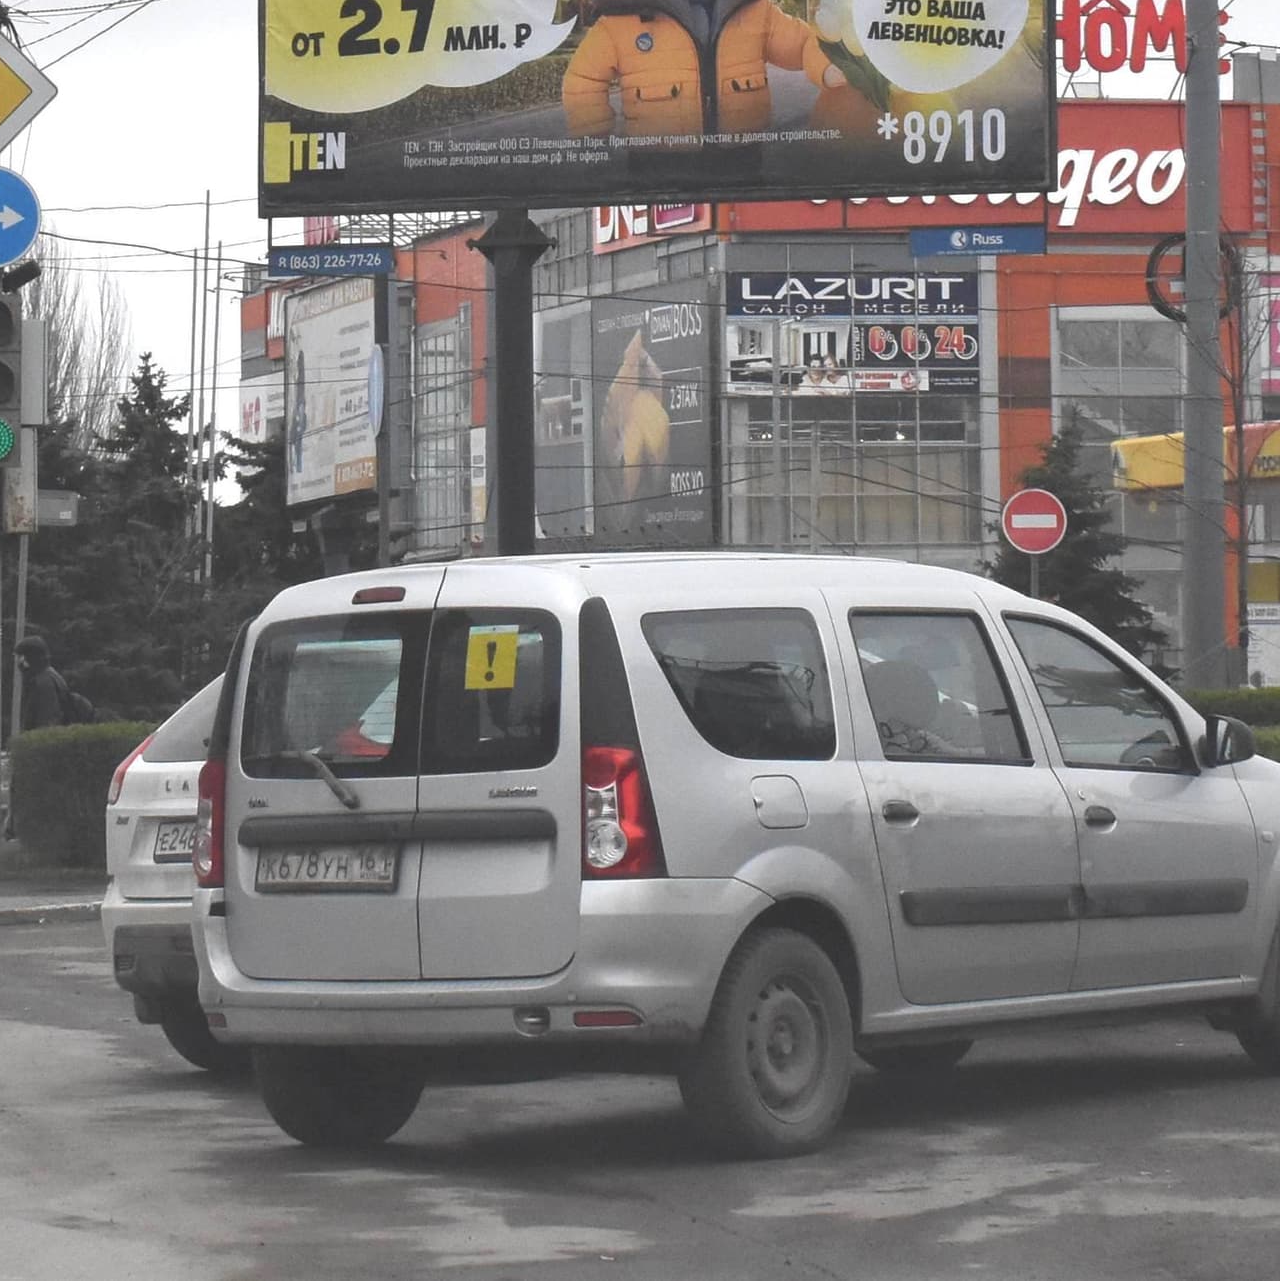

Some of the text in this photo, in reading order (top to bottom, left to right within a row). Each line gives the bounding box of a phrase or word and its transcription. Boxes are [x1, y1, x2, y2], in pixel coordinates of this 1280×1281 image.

[444, 23, 507, 52] МЛН.
[867, 21, 1006, 50] ЛЕВЕНЦОВКА!
[289, 131, 346, 172] TEN
[499, 137, 517, 151] ООО
[972, 233, 1004, 245] Russ
[290, 255, 320, 270] (863)
[323, 253, 382, 268] 226-77-26
[742, 277, 964, 300] LAZURIT
[673, 300, 702, 339] BOSS
[934, 326, 966, 354] 24
